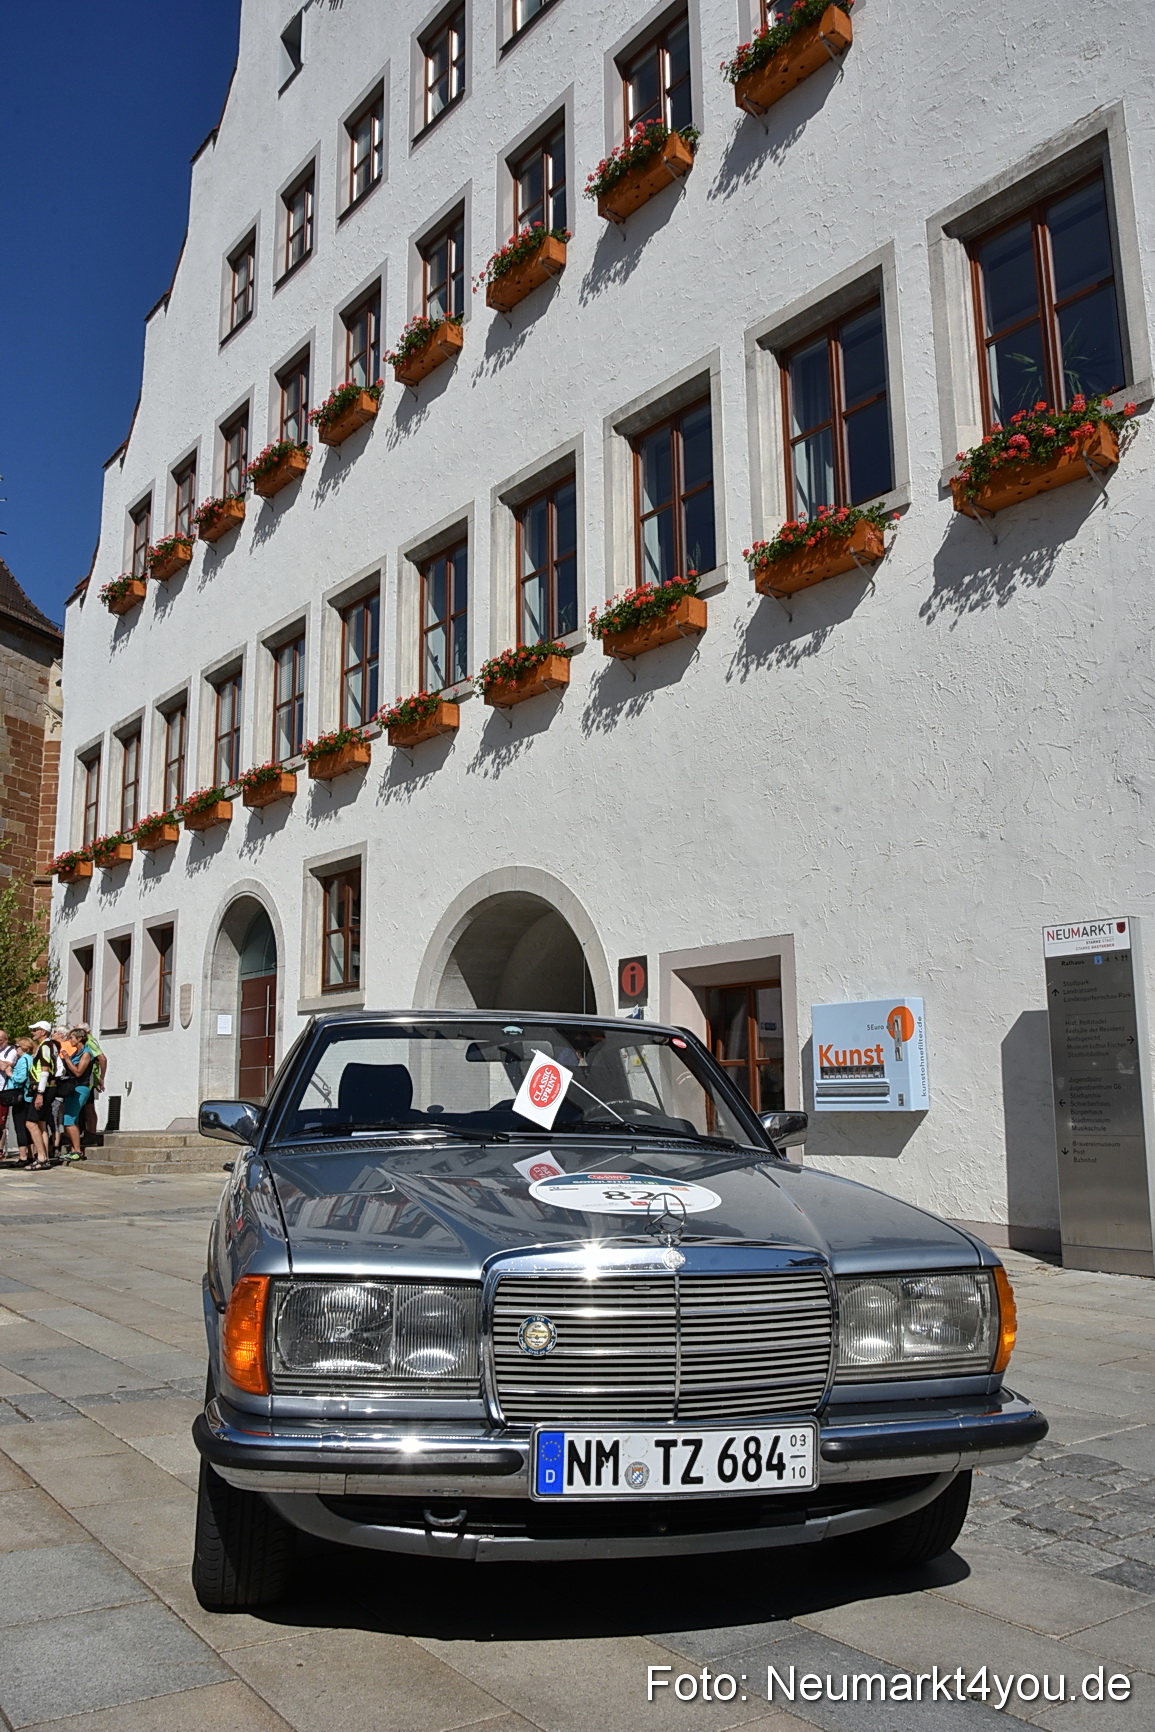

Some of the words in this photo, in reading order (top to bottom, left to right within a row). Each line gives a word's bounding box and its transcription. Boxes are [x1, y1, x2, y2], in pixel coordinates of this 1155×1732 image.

[1046, 922, 1114, 942] NEUMARKT
[1061, 959, 1085, 967] Rathaus
[818, 1044, 884, 1067] Kunst
[916, 1016, 927, 1097] kunstohnefilter.de
[533, 1067, 552, 1102] CLASSIC
[540, 1073, 557, 1103] SPRINT
[602, 1190, 663, 1201] 82
[790, 1434, 806, 1448] 03
[567, 1439, 620, 1486] NM
[654, 1438, 704, 1486] TZ
[717, 1435, 786, 1484] 684
[545, 1469, 556, 1483] D
[790, 1465, 806, 1479] 10
